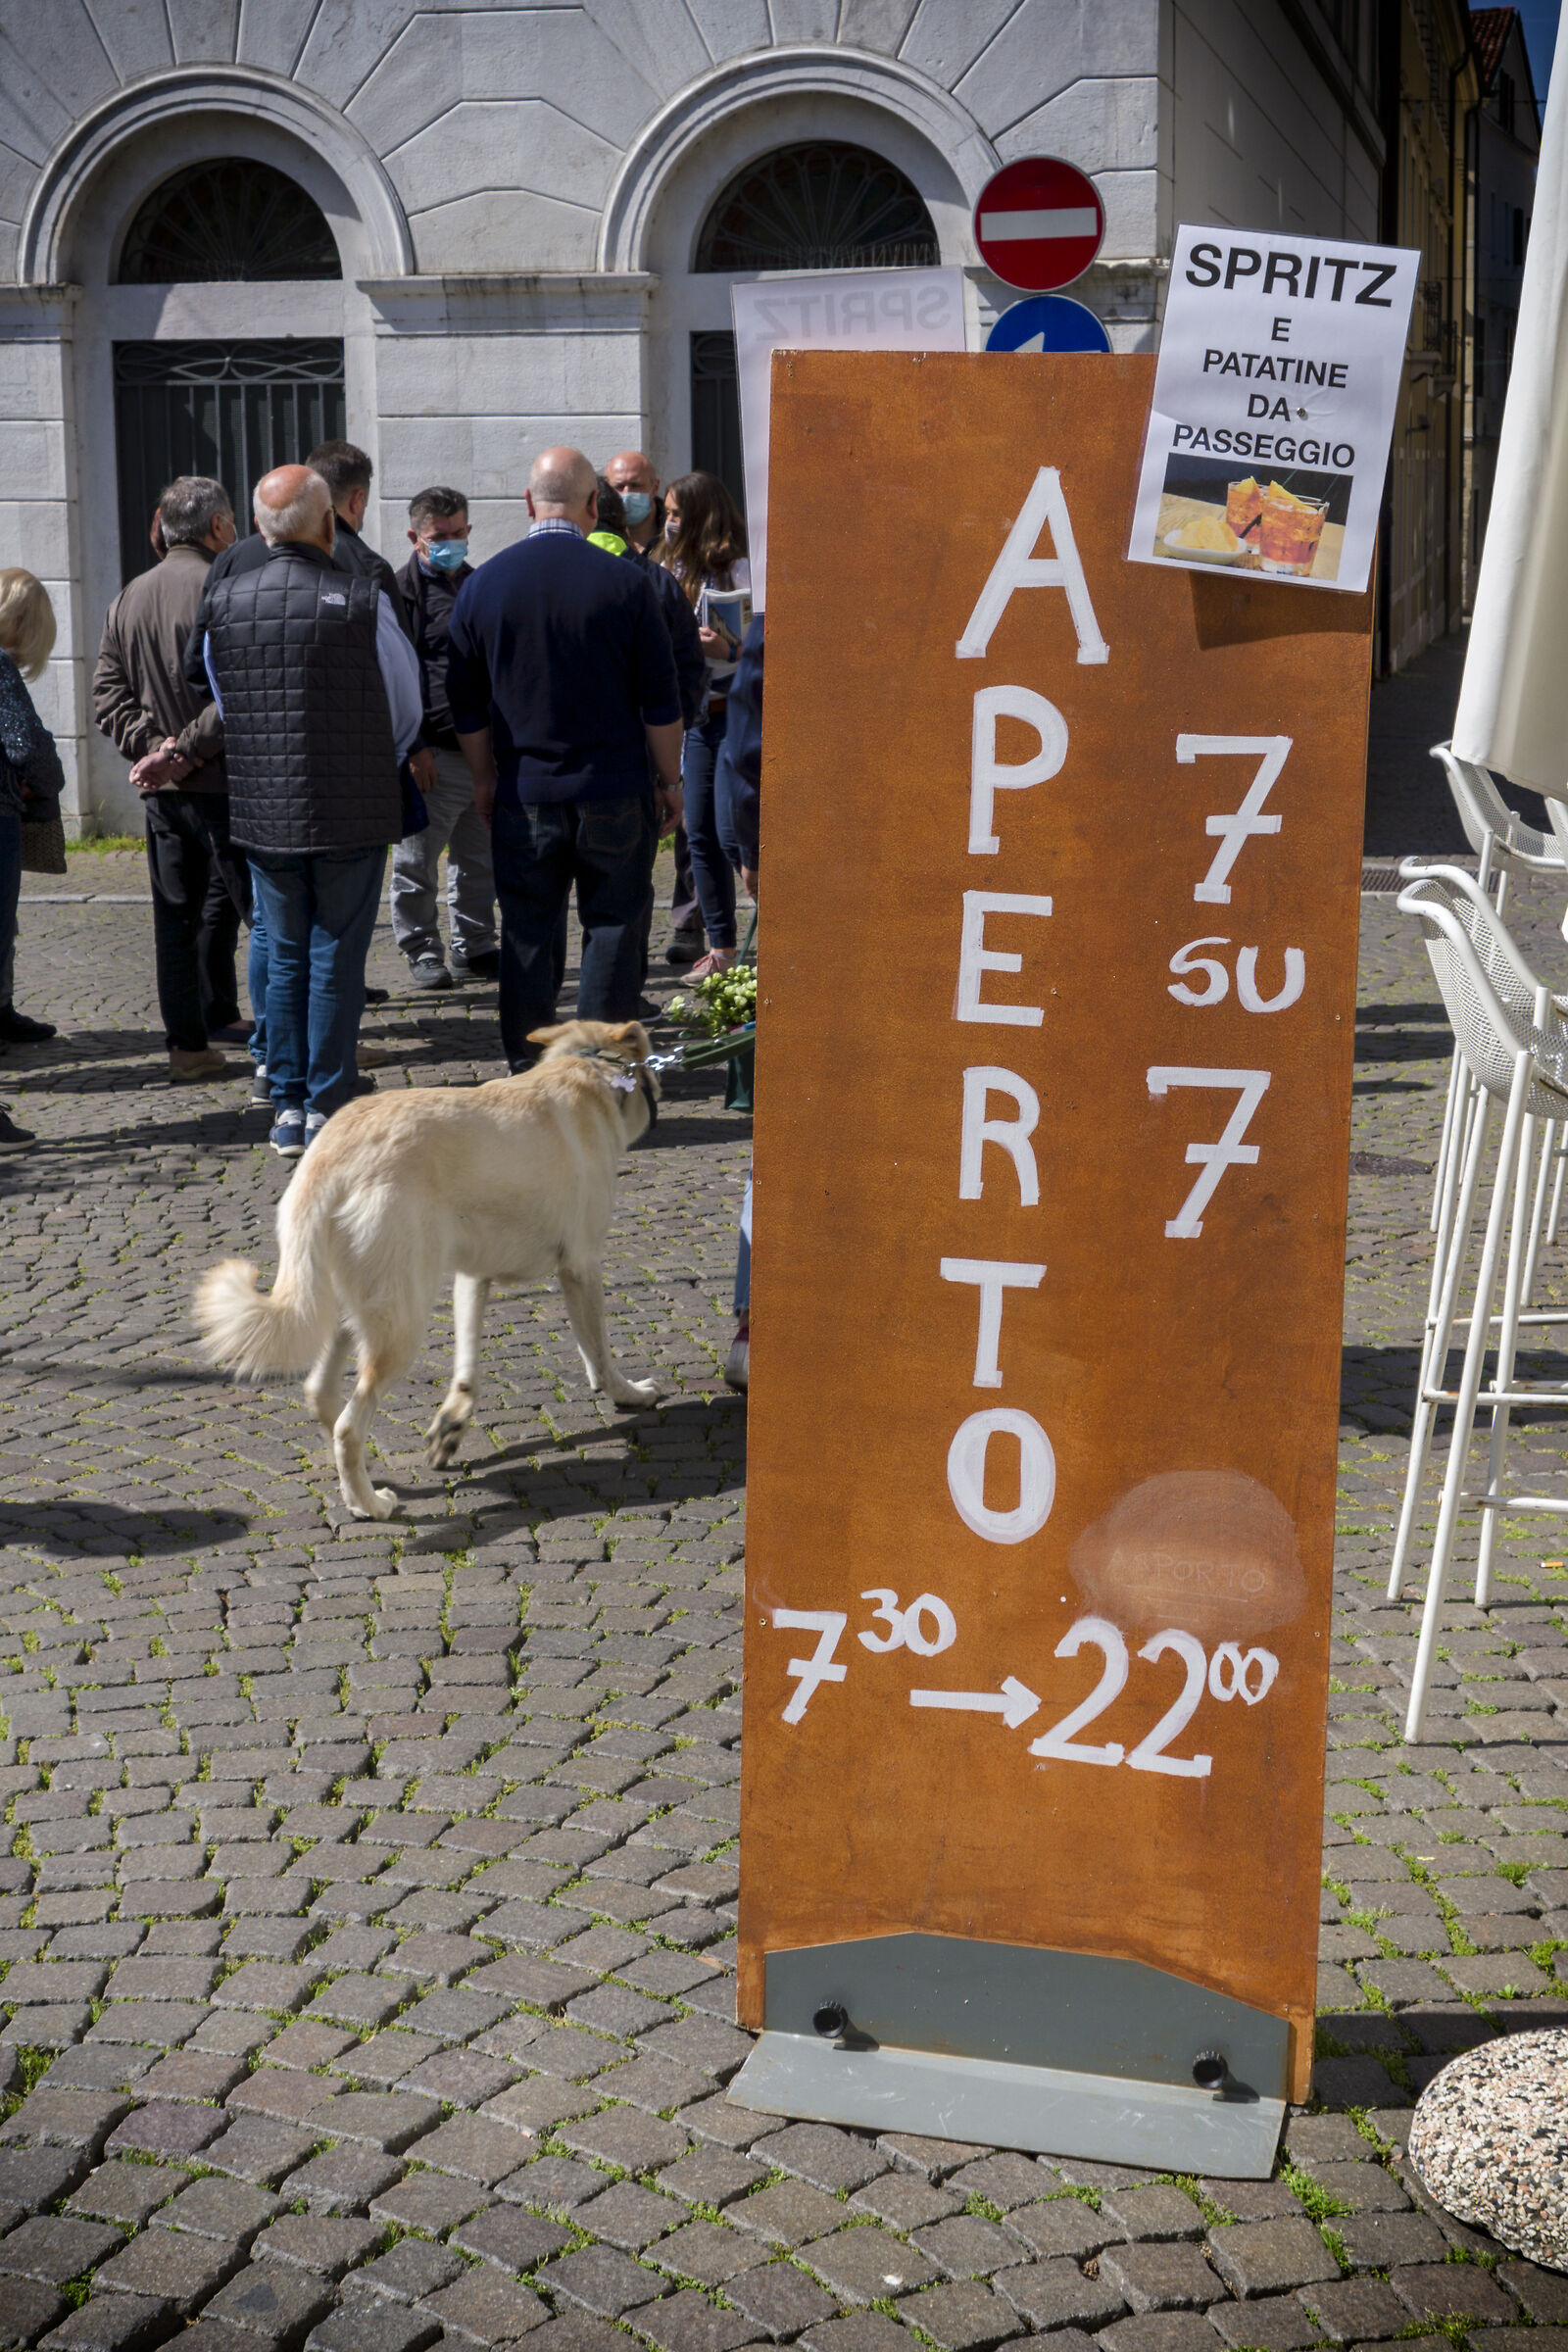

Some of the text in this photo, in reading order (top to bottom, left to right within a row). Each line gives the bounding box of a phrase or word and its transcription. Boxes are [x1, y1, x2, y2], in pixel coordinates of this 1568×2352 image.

[1186, 243, 1397, 308] SPRITZ
[1271, 317, 1292, 342] E
[1202, 349, 1348, 388] PATATINE
[1247, 393, 1291, 421] DA
[1172, 423, 1355, 468] PASSEGGIO
[1176, 734, 1293, 904] 7
[941, 466, 1109, 1544] APERTO
[1147, 1066, 1271, 1238] 7
